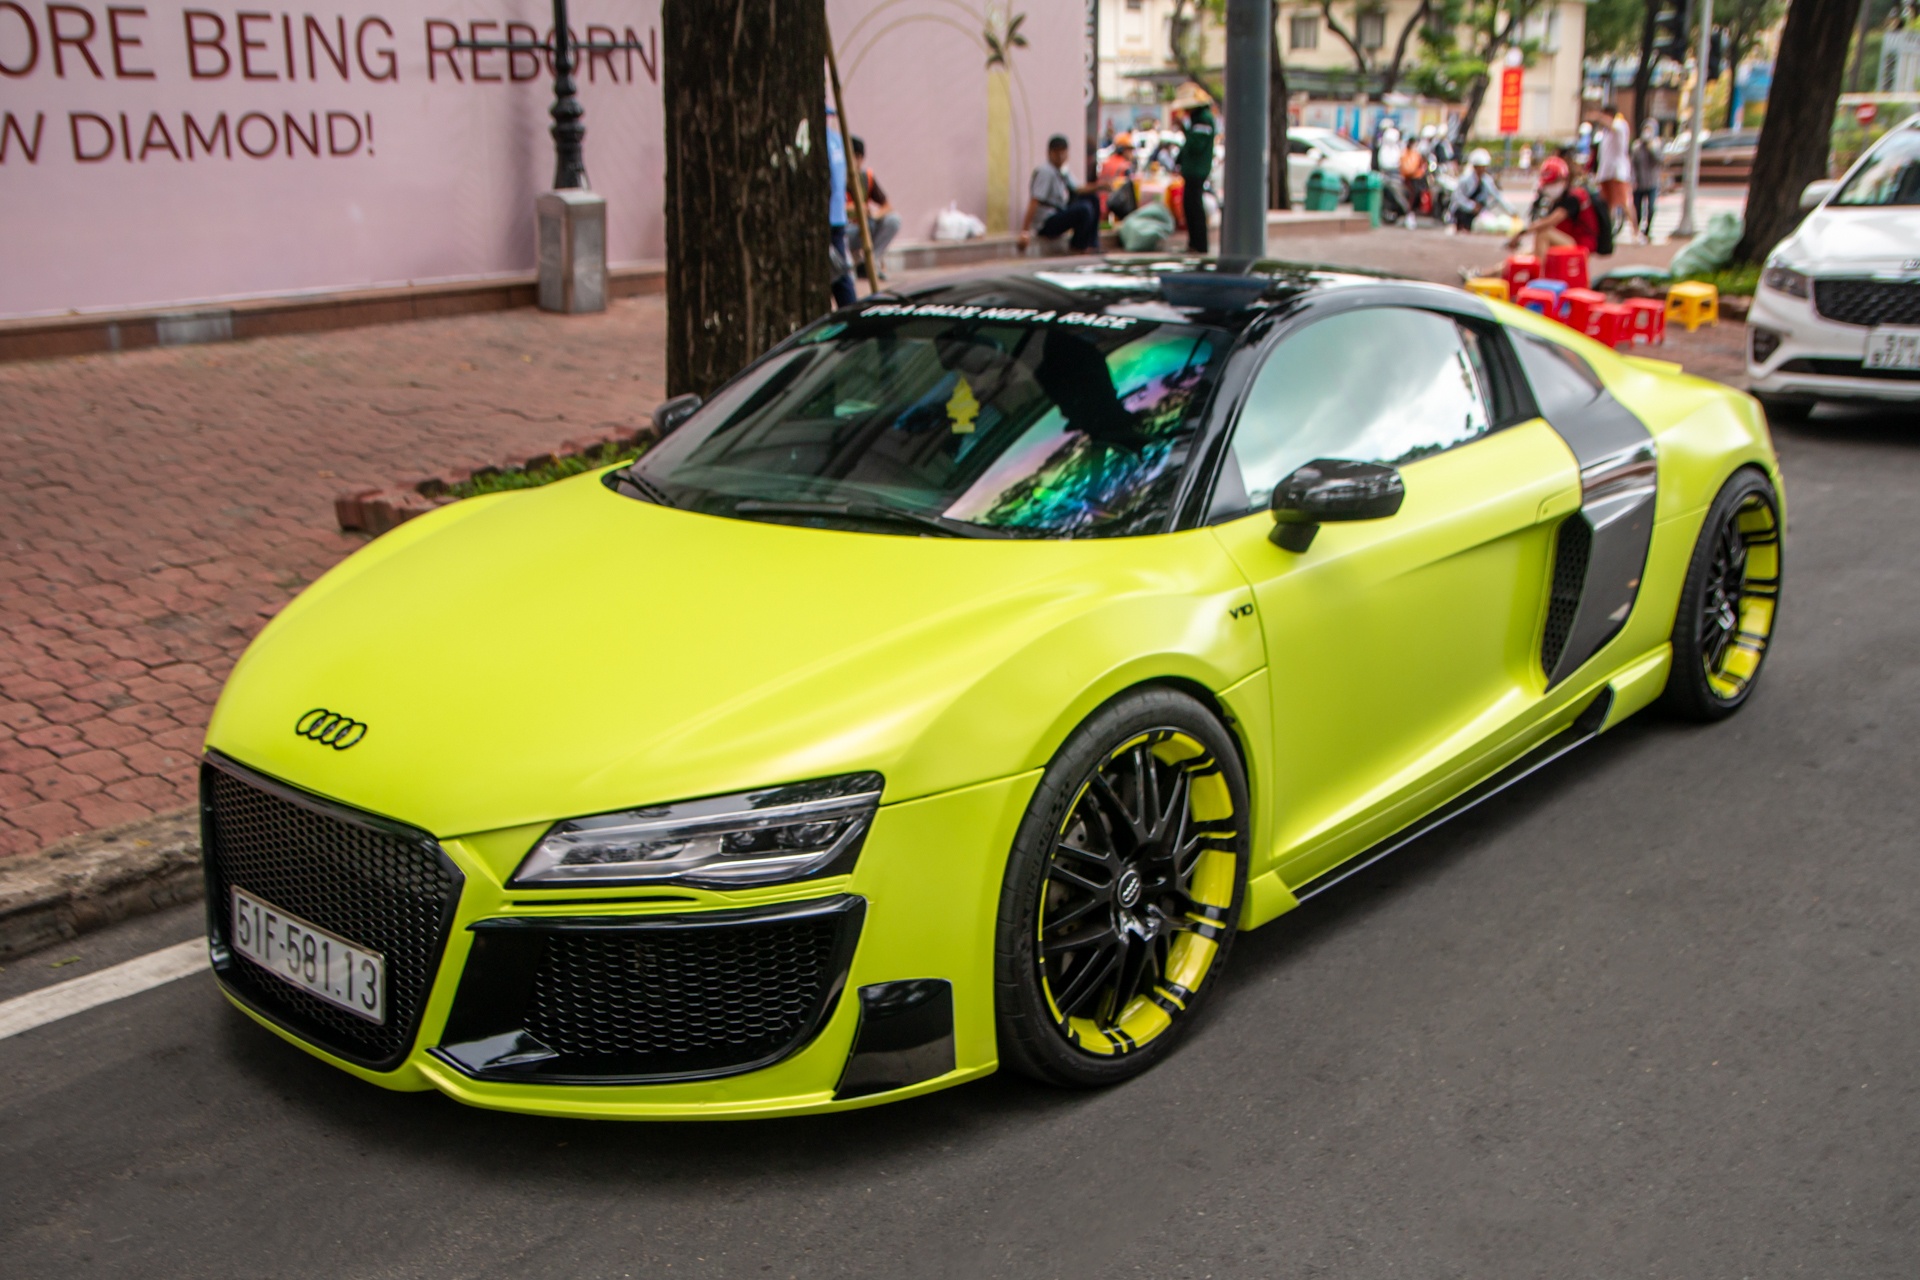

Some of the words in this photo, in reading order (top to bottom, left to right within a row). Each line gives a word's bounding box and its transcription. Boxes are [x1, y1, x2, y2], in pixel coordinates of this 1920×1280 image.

[183, 9, 398, 83] BEING
[425, 19, 657, 84] REBORN
[69, 111, 373, 163] DIAMOND!
[978, 307, 1038, 321] NOT
[1031, 310, 1057, 323] A
[1057, 311, 1137, 330] RACE
[1229, 603, 1254, 620] V10
[238, 897, 377, 1010] 51F-581.13
